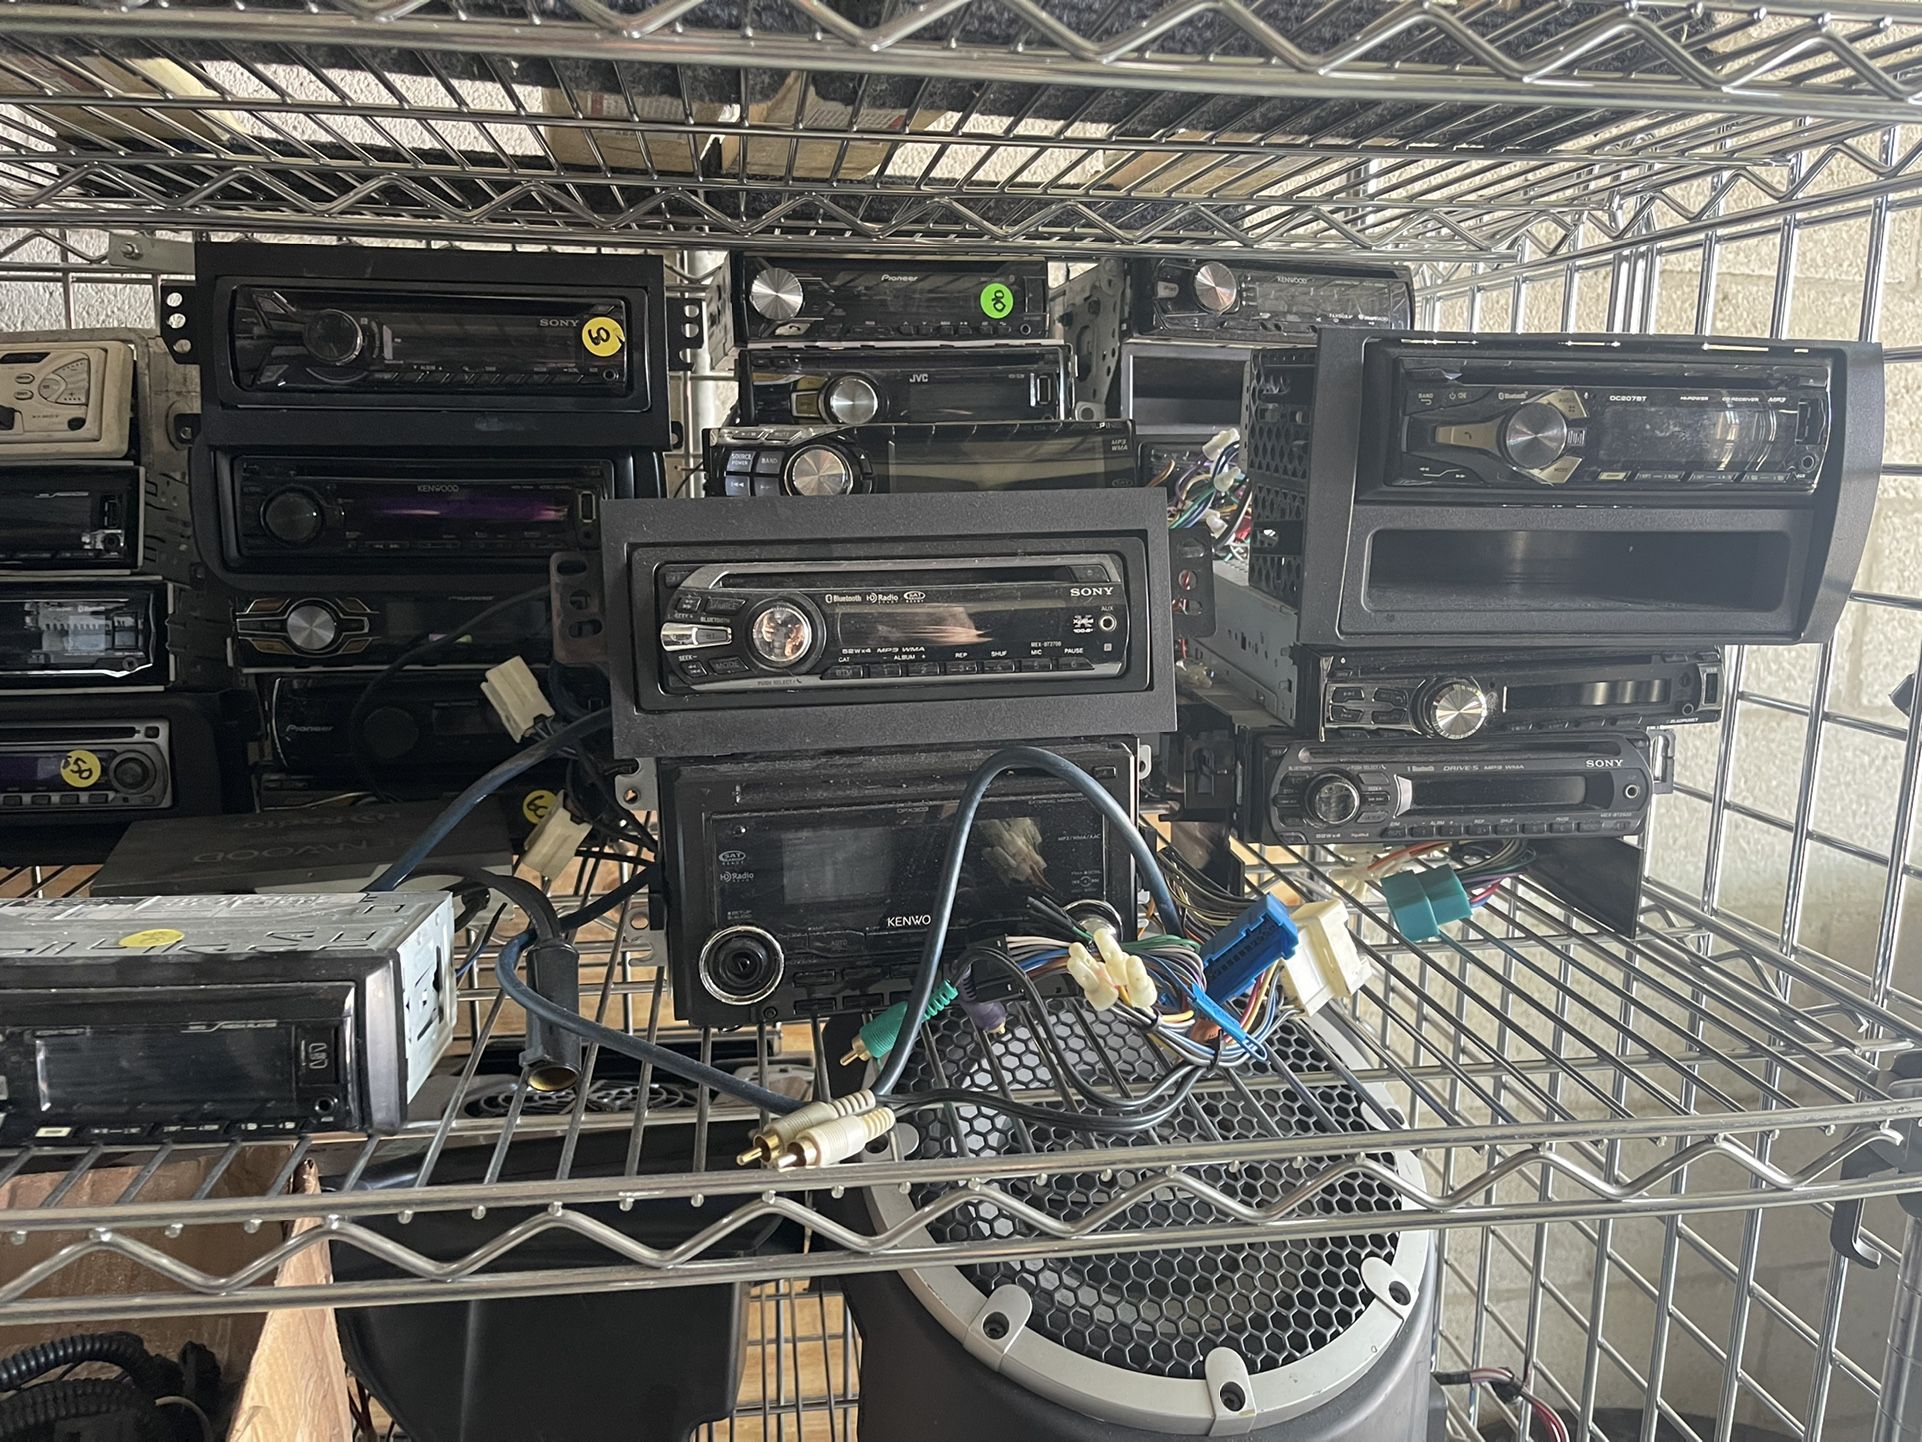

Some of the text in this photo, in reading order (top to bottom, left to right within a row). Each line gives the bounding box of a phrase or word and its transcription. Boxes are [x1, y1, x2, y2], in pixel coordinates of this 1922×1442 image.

[1277, 276, 1308, 284] KENWOOD
[540, 319, 579, 327] SONY
[909, 373, 929, 383] JVC
[417, 484, 460, 493] KENWOOD
[1070, 586, 1114, 597] SONY
[833, 593, 862, 603] Bluetooth
[878, 592, 899, 601] Radio
[286, 724, 334, 732] Pioneer
[1585, 759, 1624, 768] SONY
[731, 871, 755, 880] Radio
[887, 914, 931, 927] KENWO
